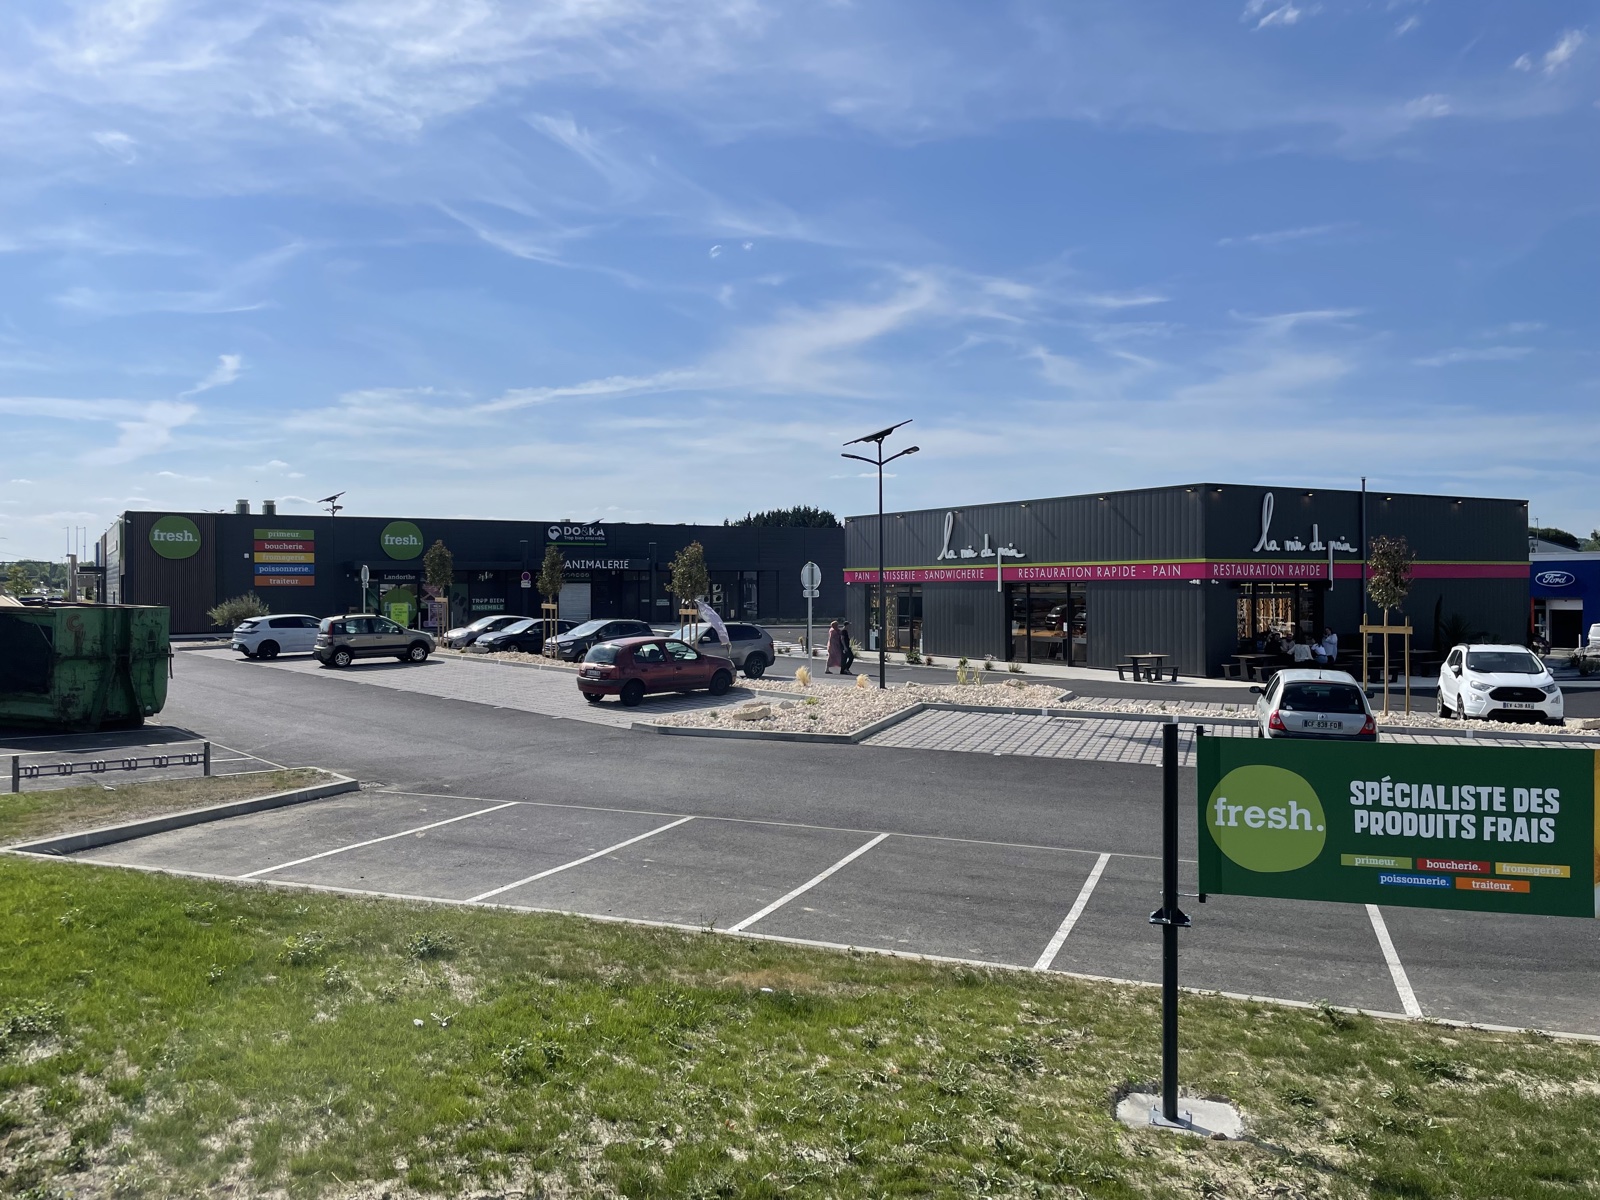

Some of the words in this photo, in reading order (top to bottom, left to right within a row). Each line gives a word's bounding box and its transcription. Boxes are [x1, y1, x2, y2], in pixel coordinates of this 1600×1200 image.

[1253, 492, 1280, 552] la
[1309, 523, 1326, 551] de
[153, 529, 198, 542] fresh.
[384, 534, 421, 546] fresh.
[937, 511, 958, 560] la
[264, 542, 305, 550] boucherie.
[564, 560, 629, 569] ANIMALERIE
[1213, 564, 1284, 576] RESTAURATION
[1288, 564, 1321, 576] RAPIDE
[854, 571, 870, 580] PAIN
[880, 570, 916, 580] ATISSERIE
[924, 569, 985, 580] SANDWICHERIE
[1018, 566, 1092, 579] RESTAURATION
[1096, 565, 1136, 578] RAPIDE
[1152, 564, 1181, 577] PAIN
[1542, 573, 1567, 584] Ford
[1350, 775, 1507, 813] SPÉCIALISTE
[1512, 787, 1560, 815] DES
[1213, 797, 1325, 832] fresh.
[1354, 808, 1476, 840] PRODUITS
[1483, 815, 1555, 844] FRAIS
[1354, 855, 1399, 867] primeur.
[1426, 859, 1482, 872] boucherie.
[1502, 863, 1564, 876] fromagerie.
[1380, 874, 1449, 887] poissonnerie.
[1471, 879, 1515, 892] traiteur.
